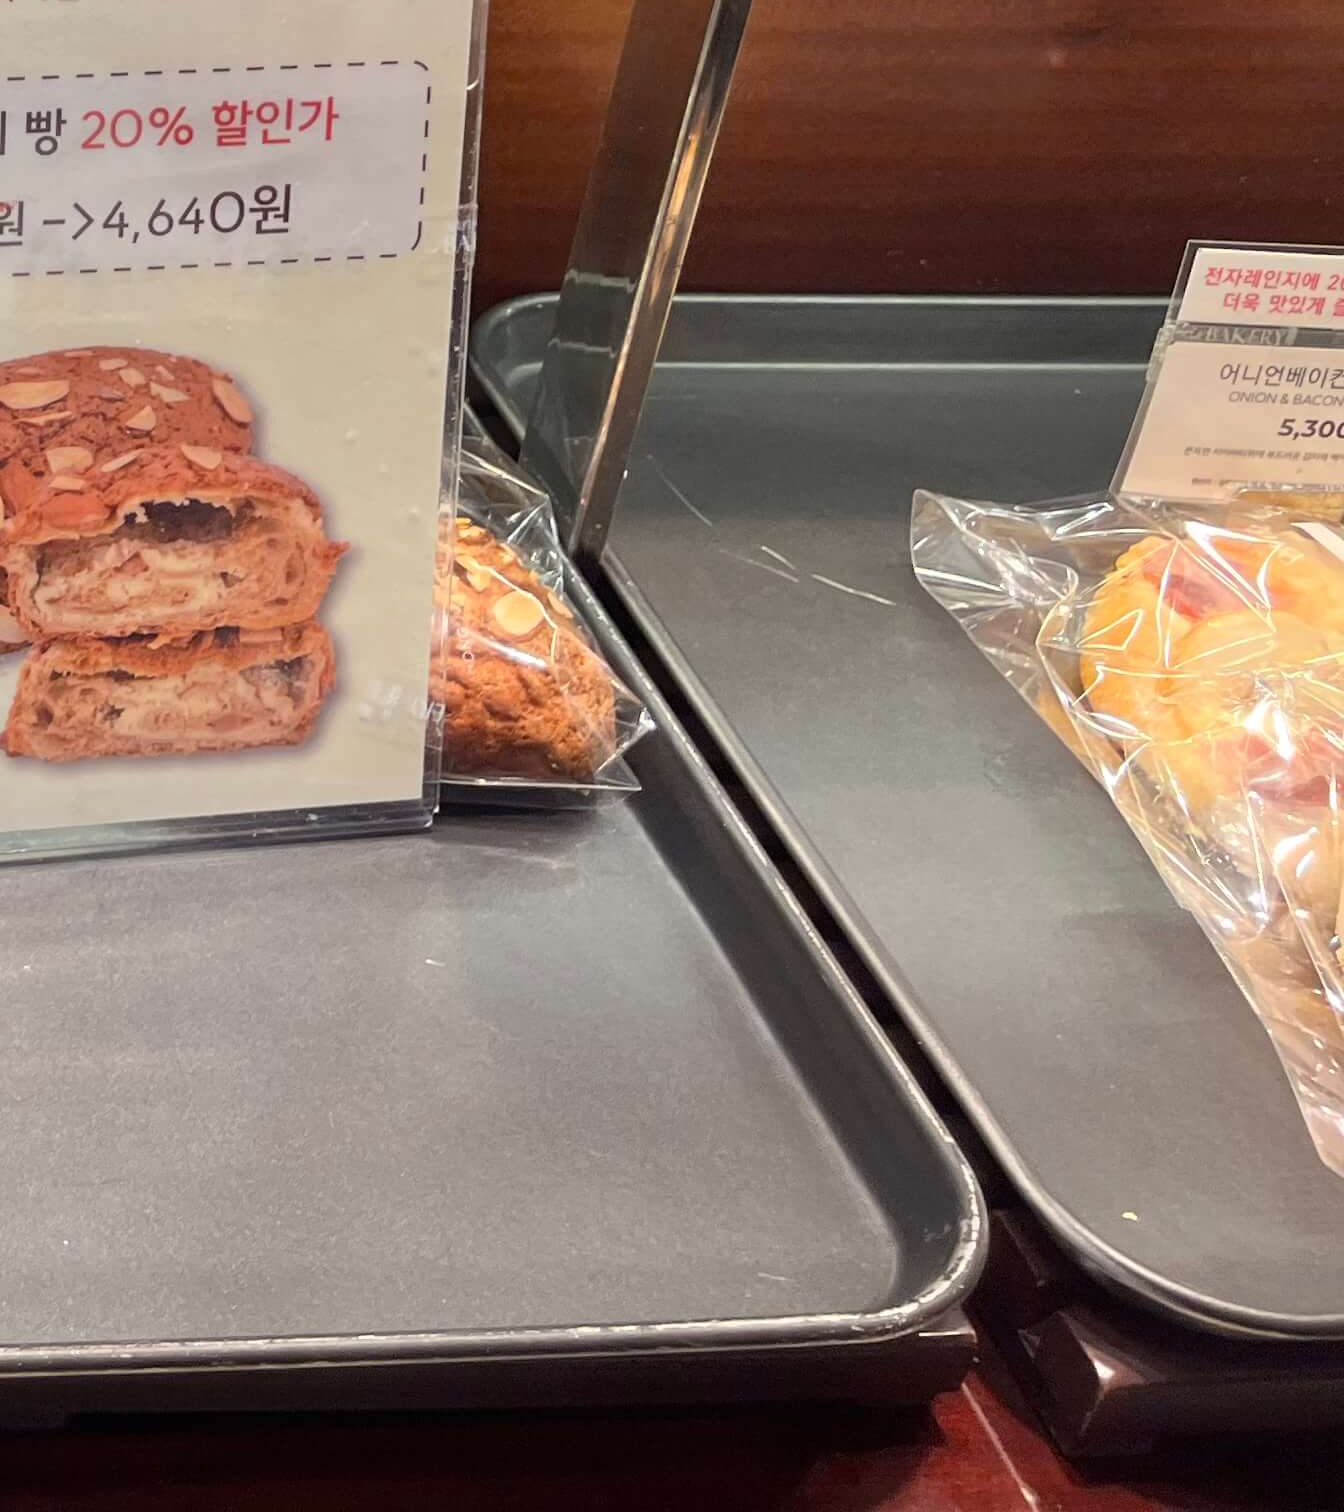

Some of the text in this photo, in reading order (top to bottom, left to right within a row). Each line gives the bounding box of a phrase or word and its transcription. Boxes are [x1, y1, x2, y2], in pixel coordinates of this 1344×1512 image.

[25, 107, 67, 156] 빵
[80, 105, 194, 150] 20%
[211, 95, 340, 148] 할인가
[1204, 266, 1322, 290] 전자레인지에
[1223, 293, 1261, 312] 더욱
[1269, 294, 1326, 316] 맛있게
[1228, 391, 1278, 405] ONION
[1279, 392, 1289, 405] &
